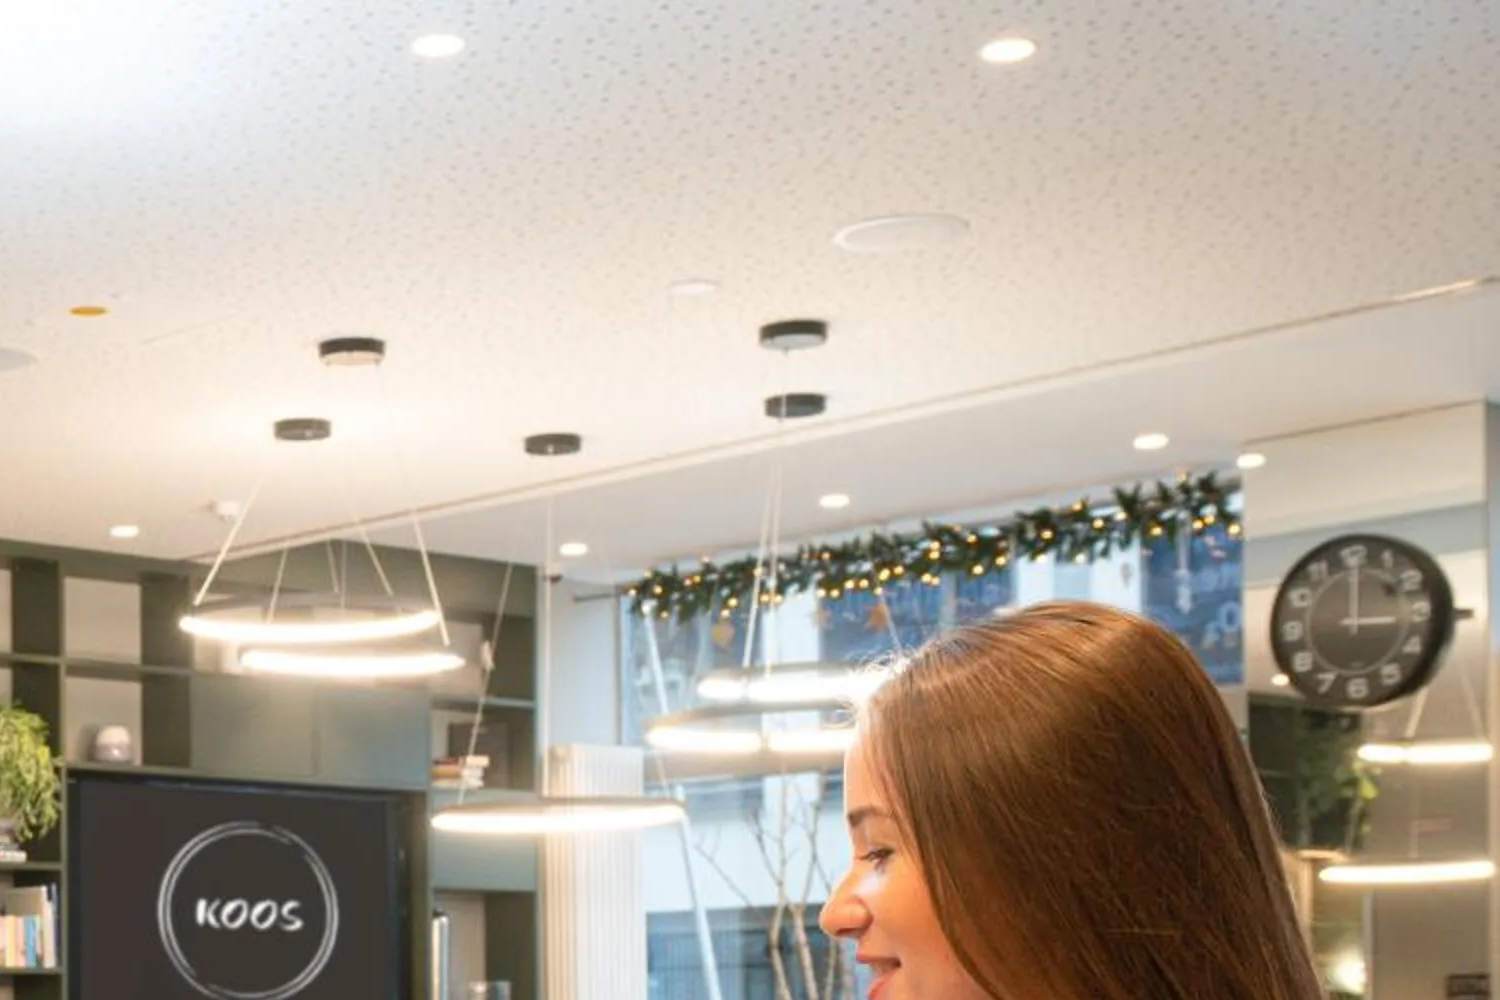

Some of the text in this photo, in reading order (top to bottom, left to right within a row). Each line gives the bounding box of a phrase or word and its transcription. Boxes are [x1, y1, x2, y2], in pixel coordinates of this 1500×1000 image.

[1381, 550, 1394, 568] 1
[1401, 569, 1423, 591] 2
[1411, 601, 1431, 623] 3
[1282, 620, 1303, 642] 9
[1403, 634, 1421, 654] 4
[1292, 651, 1313, 673] 8
[1316, 671, 1338, 694] 7
[1380, 662, 1402, 686] 5
[1346, 677, 1369, 699] 6
[196, 898, 304, 931] KOOS
